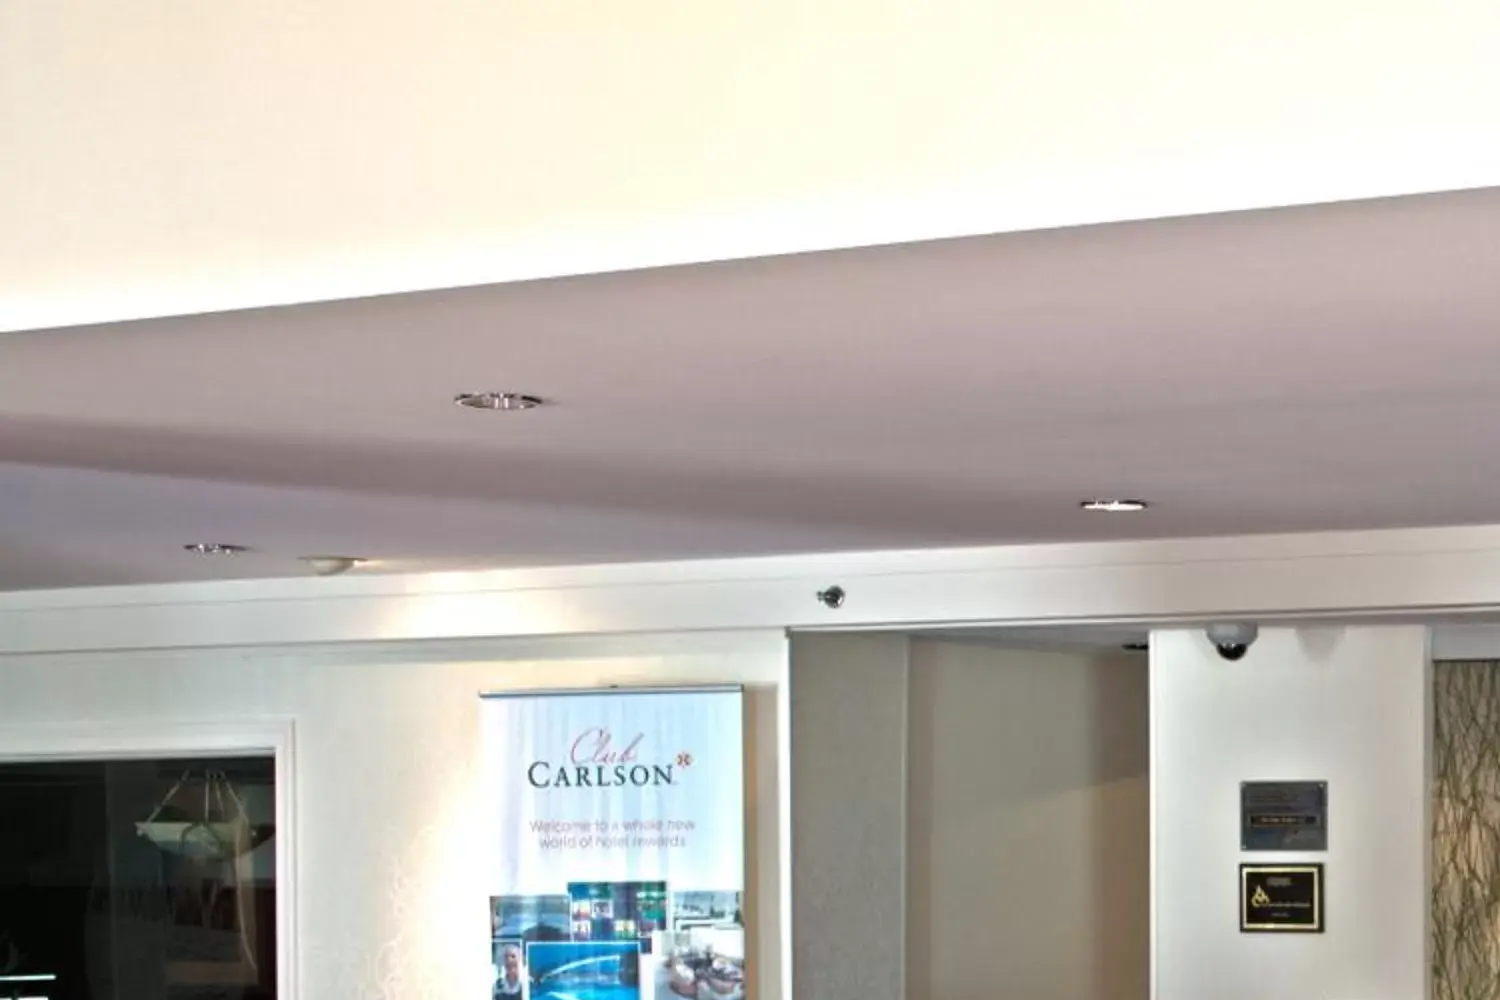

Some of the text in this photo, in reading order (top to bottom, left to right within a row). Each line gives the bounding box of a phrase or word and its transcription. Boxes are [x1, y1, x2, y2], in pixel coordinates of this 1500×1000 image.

[570, 727, 645, 766] Club
[527, 761, 673, 788] CARLSON
[529, 819, 591, 833] Welcome
[594, 819, 609, 833] to
[539, 835, 578, 849] world
[579, 835, 593, 849] of
